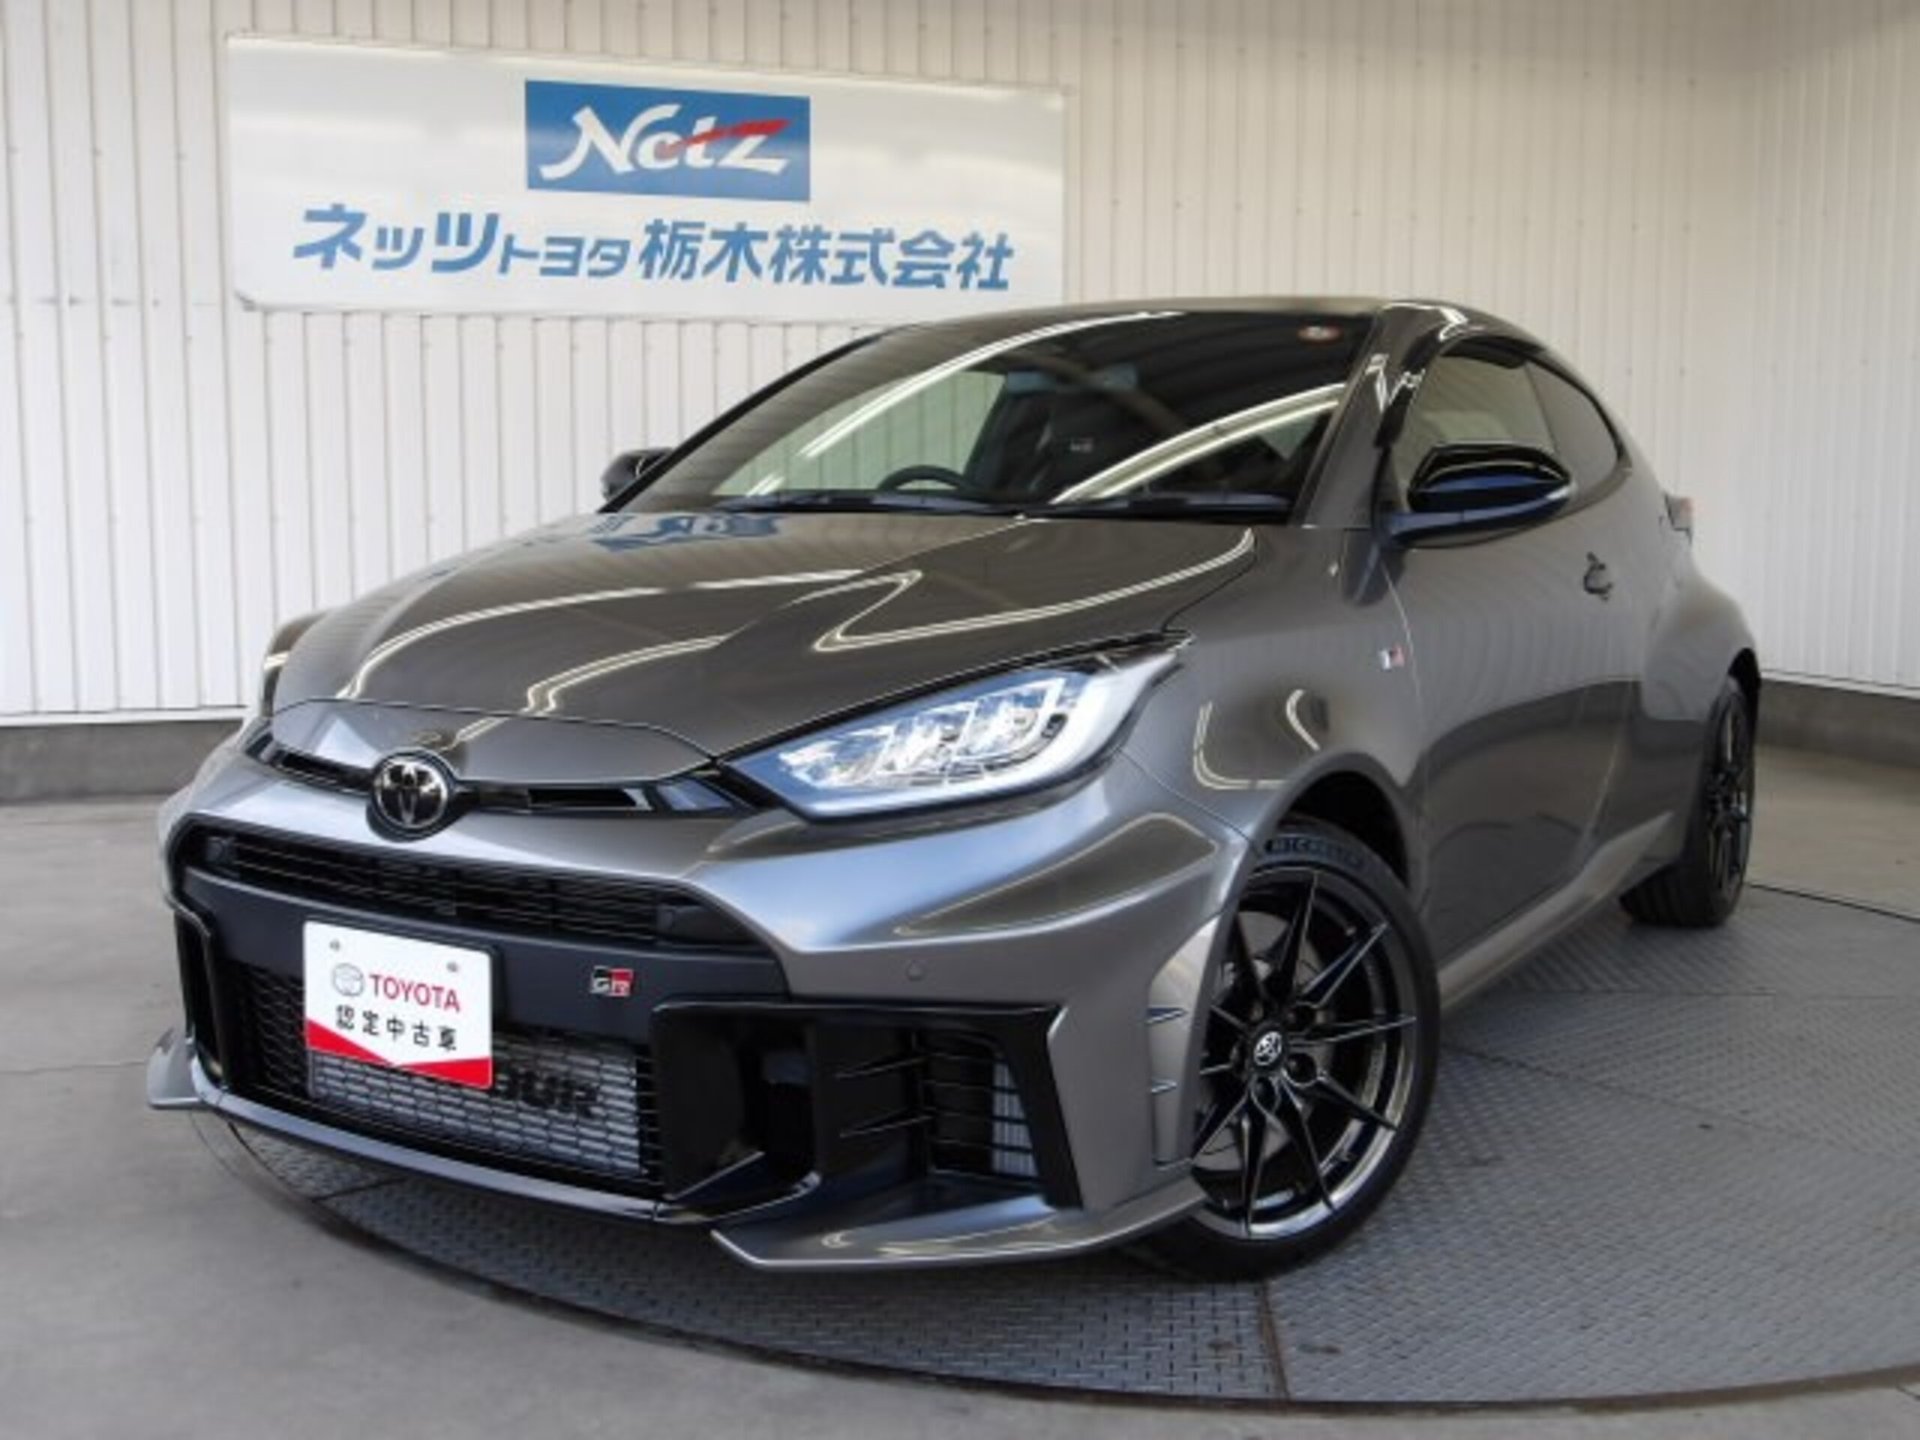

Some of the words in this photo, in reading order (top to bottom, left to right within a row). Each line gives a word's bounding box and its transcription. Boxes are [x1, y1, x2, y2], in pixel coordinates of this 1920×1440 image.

[539, 104, 790, 181] Netz
[293, 203, 1014, 290] ネッツトヨタ栃木株式会社
[369, 973, 461, 1013] TOYOTA
[335, 1003, 457, 1051] 認定中古車
